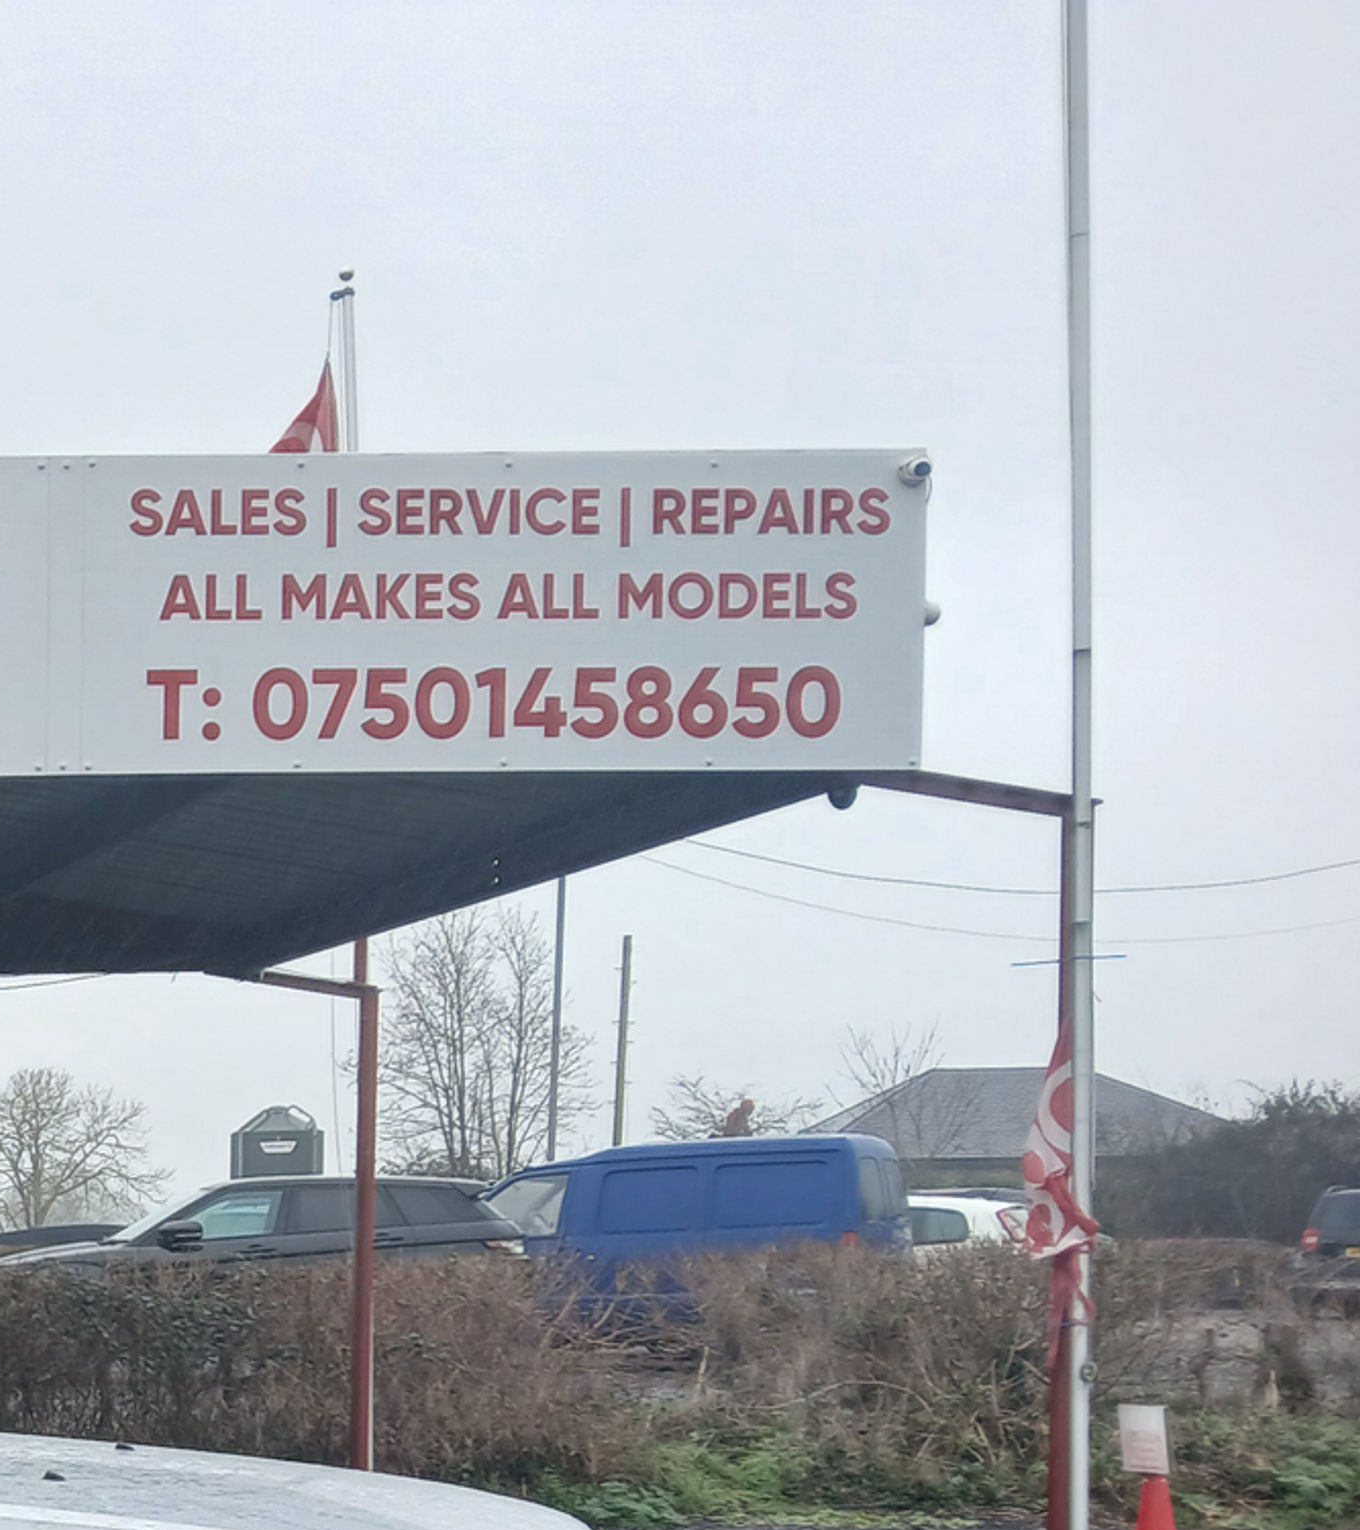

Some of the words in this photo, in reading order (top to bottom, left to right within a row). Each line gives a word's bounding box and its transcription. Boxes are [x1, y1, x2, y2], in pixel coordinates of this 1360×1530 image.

[128, 488, 308, 536] SALES
[357, 487, 601, 536] SERVICE
[651, 487, 892, 536] REPAIRS
[160, 573, 262, 621] ALL
[281, 572, 480, 621] MAKES
[497, 571, 599, 620] ALL
[617, 571, 857, 620] MODELS
[146, 669, 222, 741] T:
[251, 665, 843, 741] 07501458650
